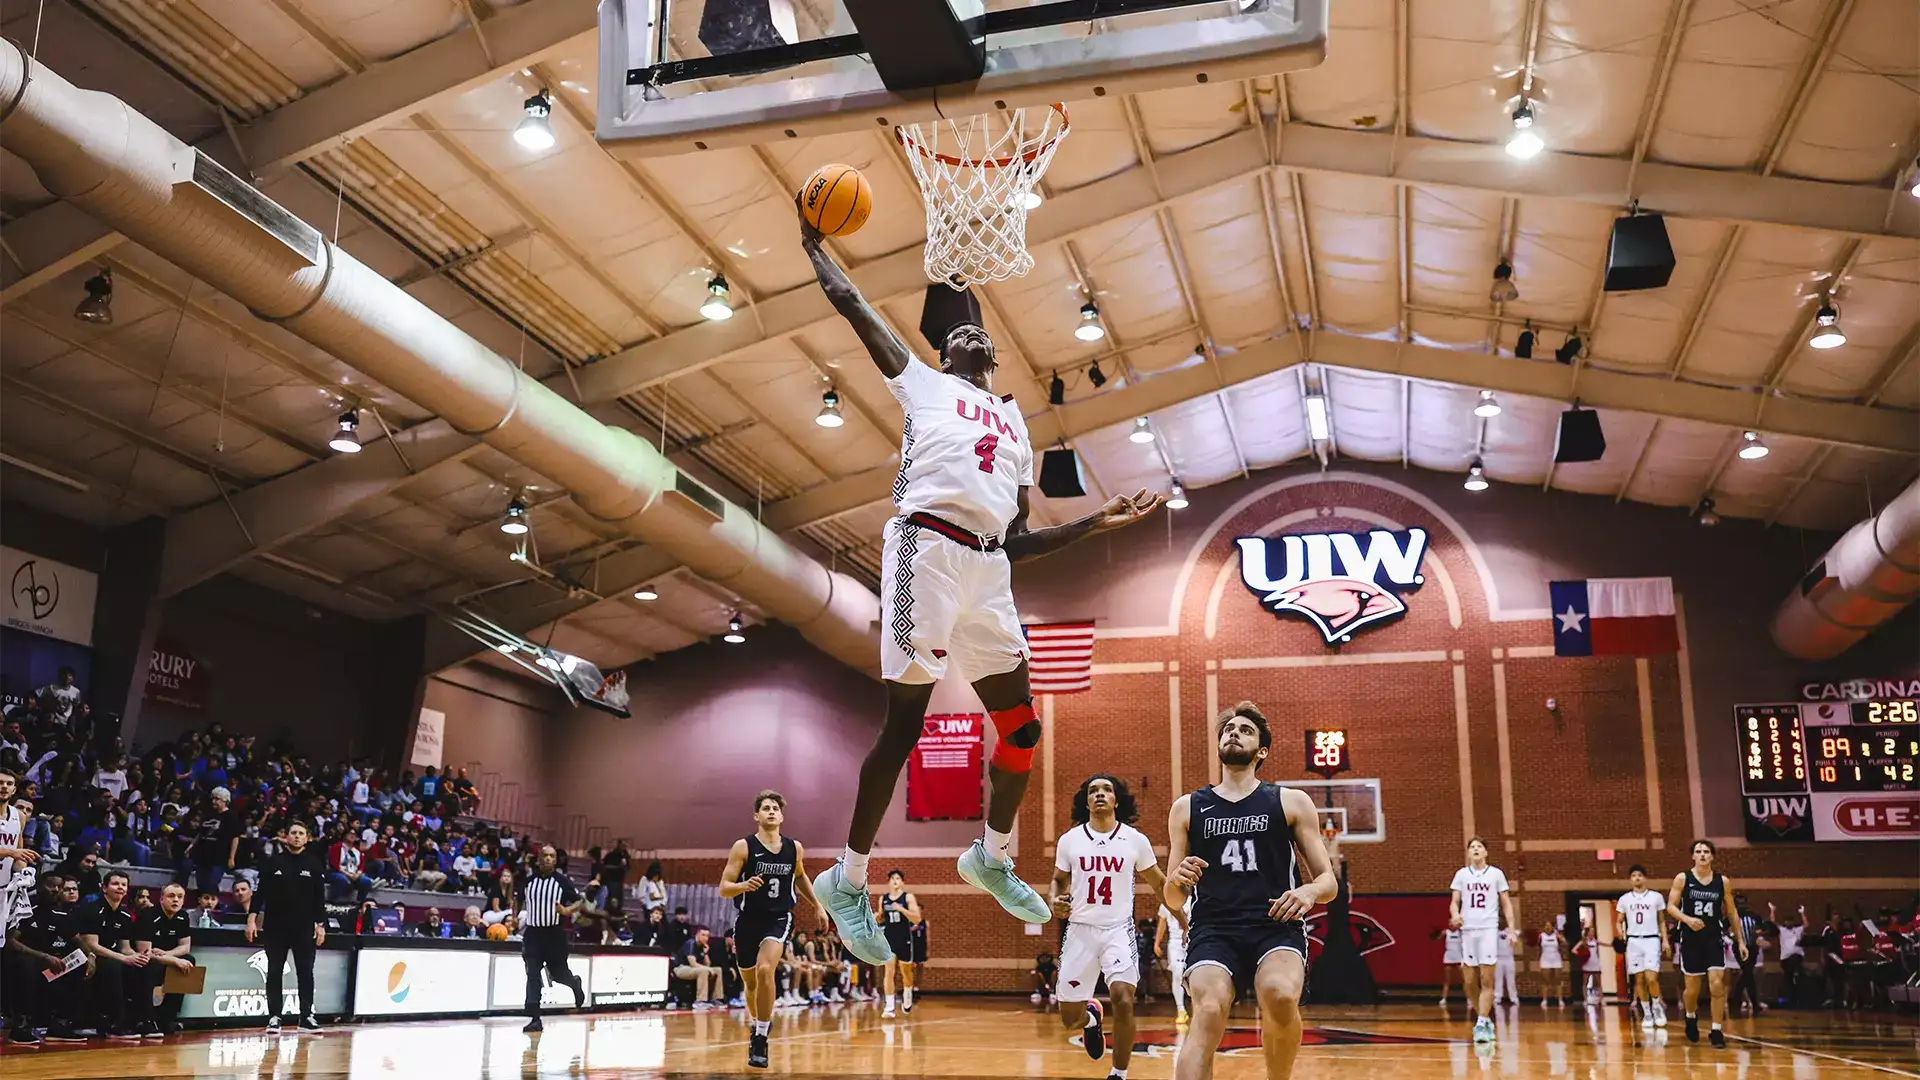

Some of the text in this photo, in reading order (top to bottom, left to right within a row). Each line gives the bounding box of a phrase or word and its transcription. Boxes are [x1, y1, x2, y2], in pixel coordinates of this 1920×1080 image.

[807, 177, 828, 211] NCAA
[957, 398, 1019, 445] UIW
[974, 432, 1000, 475] 4
[1236, 527, 1427, 592] UIW
[1868, 701, 1918, 723] 2:26
[939, 719, 973, 734] UIW
[1821, 728, 1840, 737] UIW
[1770, 729, 1779, 742] 2
[1771, 742, 1781, 755] 0
[1822, 738, 1851, 759] 89
[1884, 738, 1896, 756] 2
[1314, 745, 1340, 767] 28
[1773, 754, 1782, 767] 2
[1775, 767, 1783, 780] 2
[1795, 766, 1805, 780] 0
[1820, 766, 1837, 783] 10
[1854, 766, 1862, 782] 1
[1748, 798, 1808, 819] UIW
[1204, 814, 1269, 839] PIRATES
[1079, 855, 1124, 872] UIW
[1221, 840, 1259, 872] 41
[767, 878, 780, 898] 3
[1087, 875, 1112, 905] 14
[1467, 882, 1491, 892] UIW
[1470, 893, 1486, 908] 12
[1694, 900, 1714, 917] 24
[1636, 912, 1643, 925] 0
